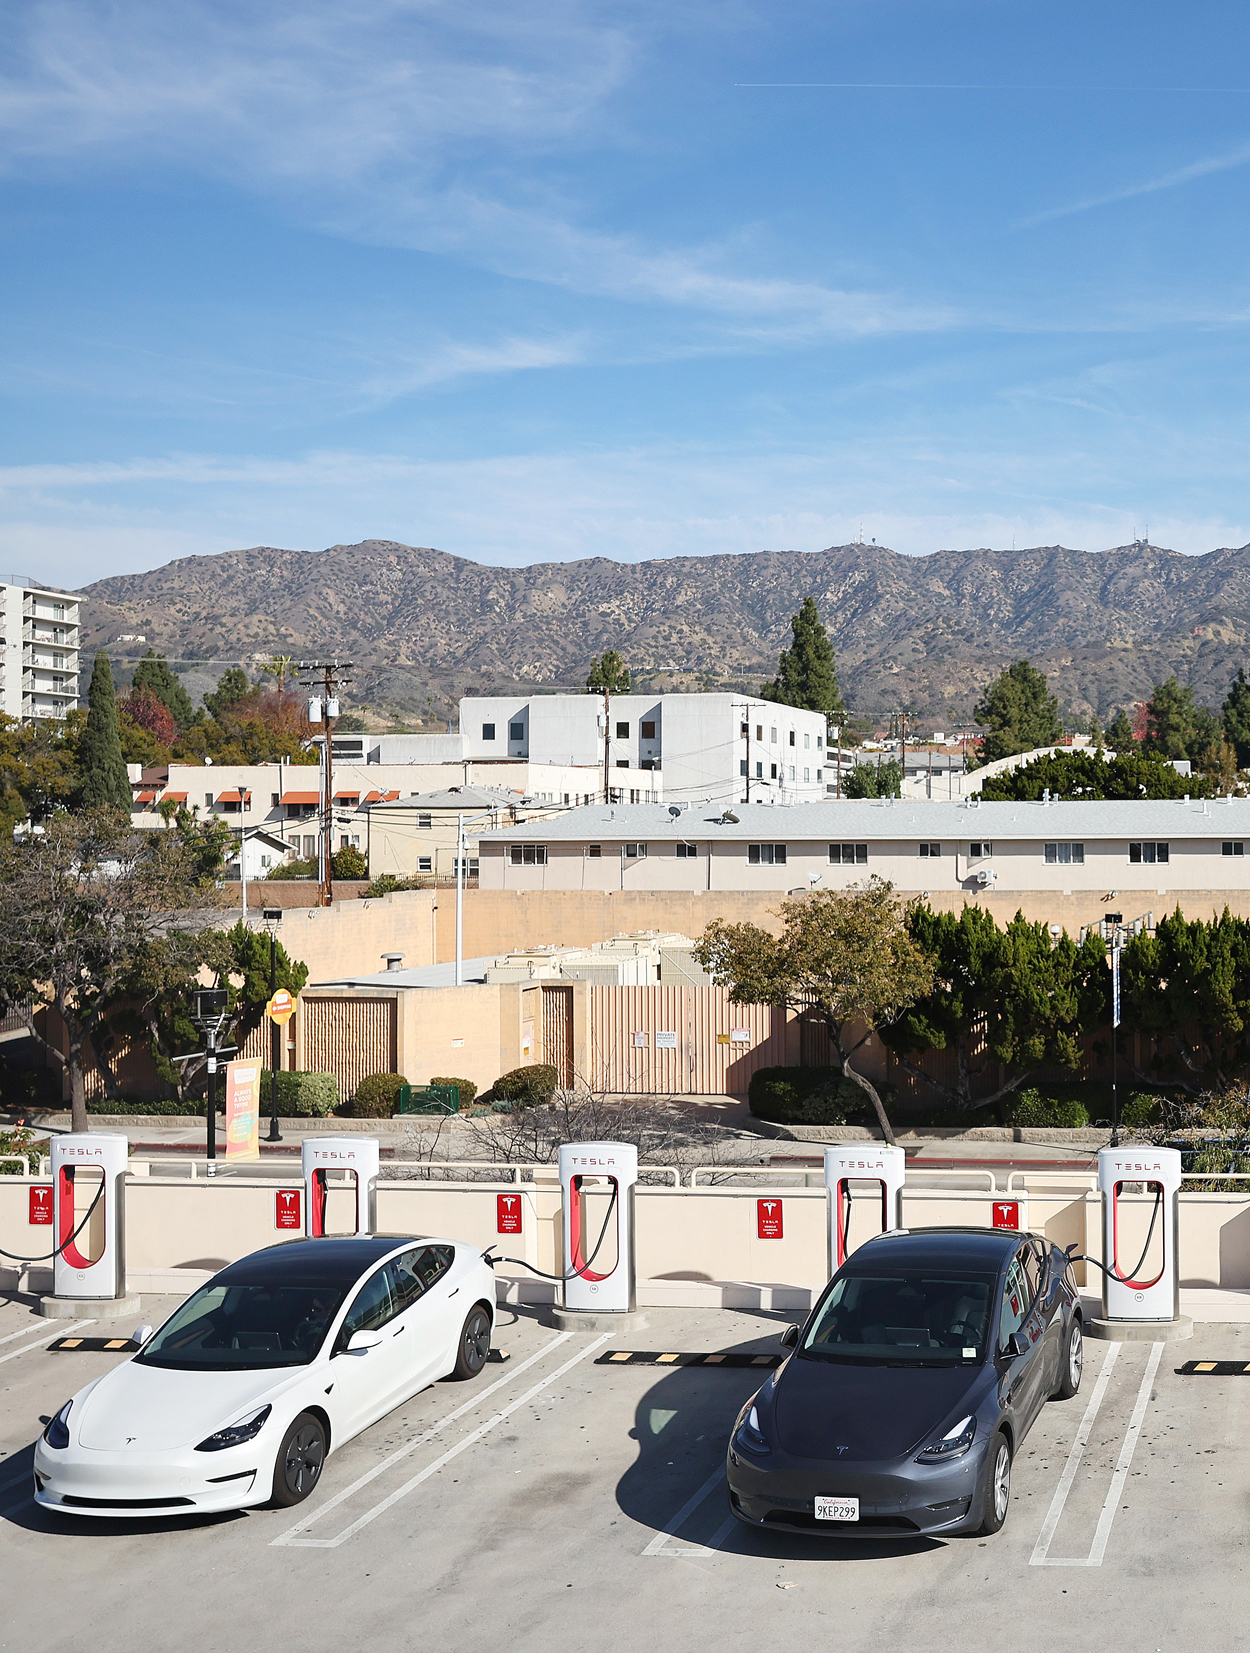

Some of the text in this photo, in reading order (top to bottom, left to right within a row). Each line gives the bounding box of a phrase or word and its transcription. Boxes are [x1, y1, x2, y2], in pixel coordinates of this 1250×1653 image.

[233, 1088, 252, 1097] ALWAYS
[839, 1160, 883, 1168] TESLA
[817, 1505, 856, 1518] 9KEP299
